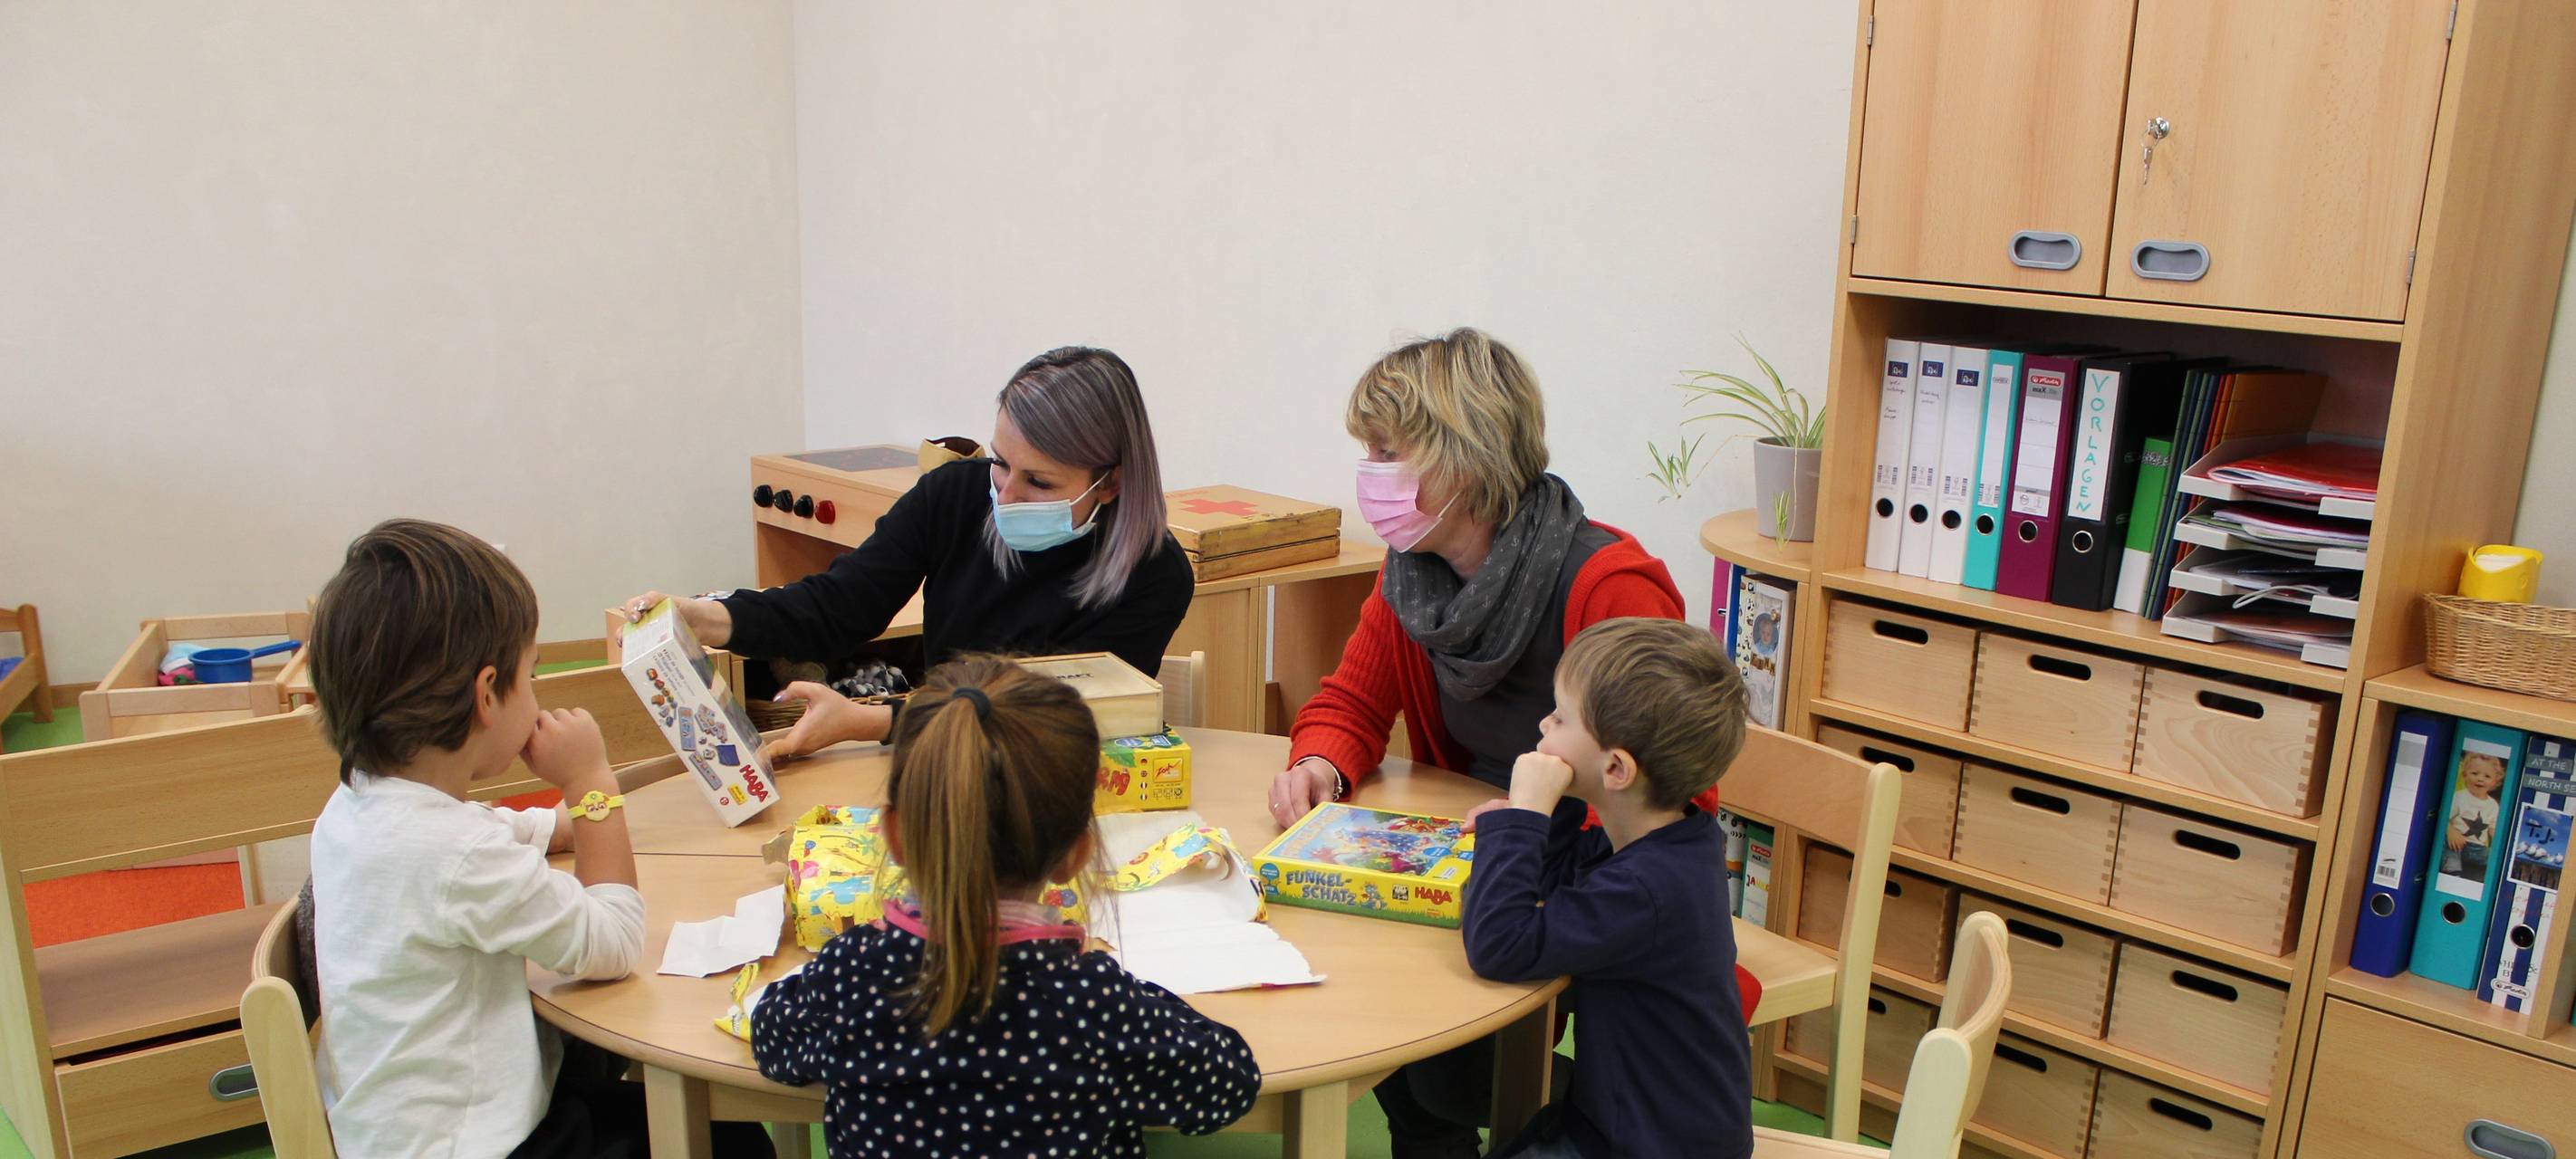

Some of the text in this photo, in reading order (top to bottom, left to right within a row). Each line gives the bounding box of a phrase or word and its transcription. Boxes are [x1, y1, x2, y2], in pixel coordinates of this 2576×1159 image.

[2075, 373, 2110, 512] VORLAGEN
[2531, 759, 2566, 771] AT THE
[739, 764, 768, 803] HABA
[2528, 778, 2562, 791] NORTH
[1285, 869, 1352, 887] FUNKEL-
[1302, 885, 1357, 905] SCHATZ
[1415, 886, 1452, 905] HABA
